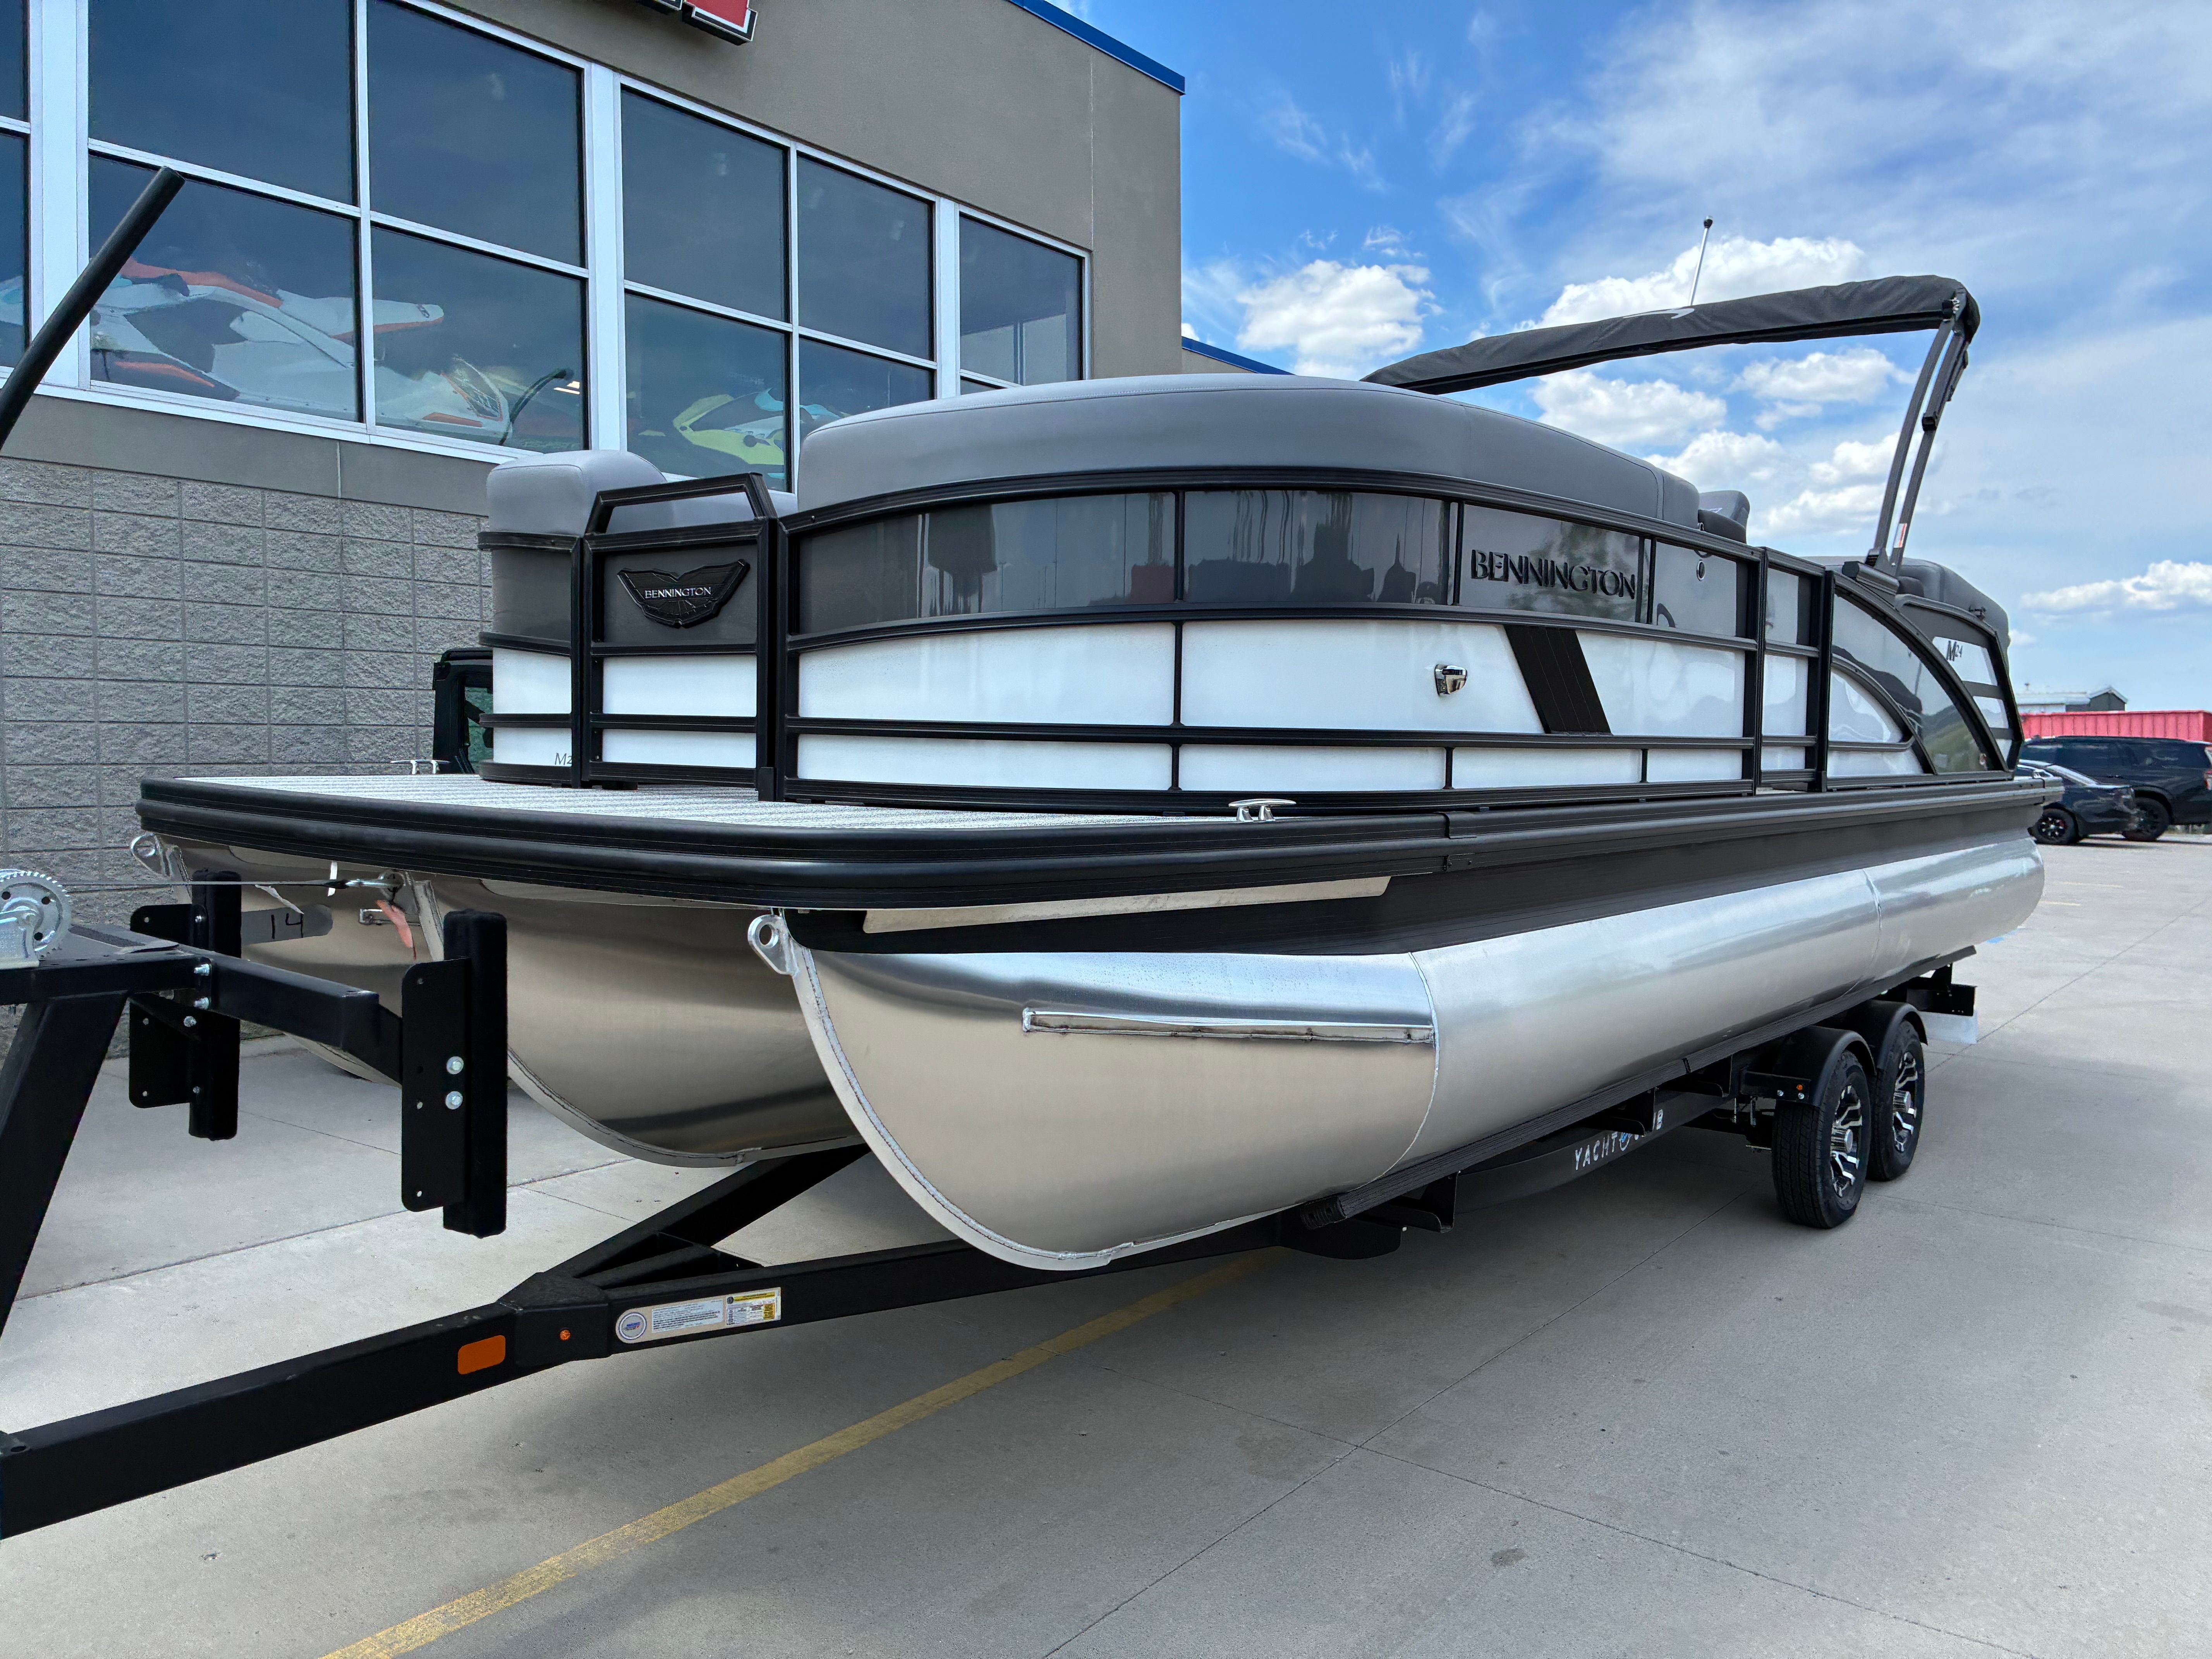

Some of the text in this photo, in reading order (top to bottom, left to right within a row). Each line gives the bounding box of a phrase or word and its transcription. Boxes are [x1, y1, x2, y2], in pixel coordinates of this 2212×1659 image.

[1471, 549, 1635, 600] BENNINGTON
[644, 587, 711, 599] BENNINGTON
[271, 913, 303, 939] 14
